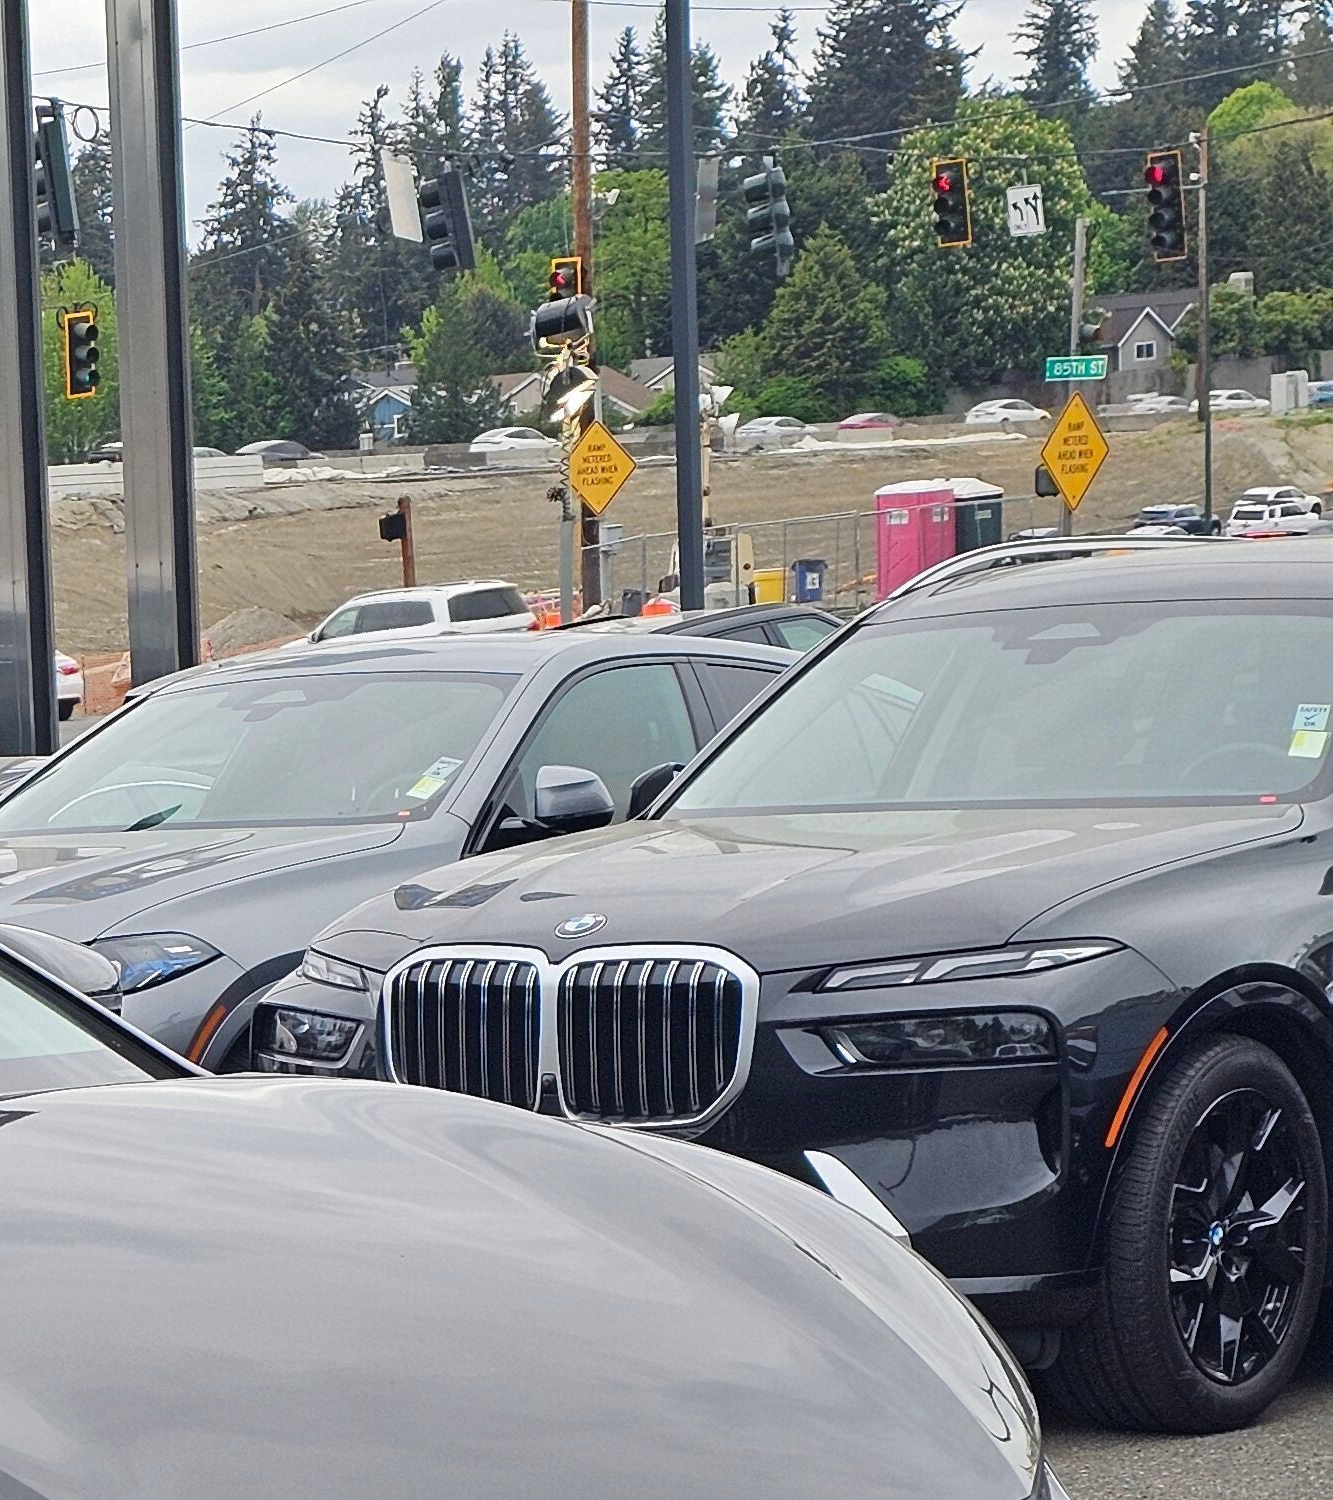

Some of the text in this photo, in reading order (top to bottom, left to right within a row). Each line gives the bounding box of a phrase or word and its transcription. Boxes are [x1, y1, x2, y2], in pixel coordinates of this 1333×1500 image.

[1053, 360, 1104, 376] 85TH ST
[1078, 448, 1093, 459] WHEN
[600, 464, 619, 474] WHEN
[1061, 463, 1089, 475] FLASHING
[582, 476, 614, 486] FLASHING
